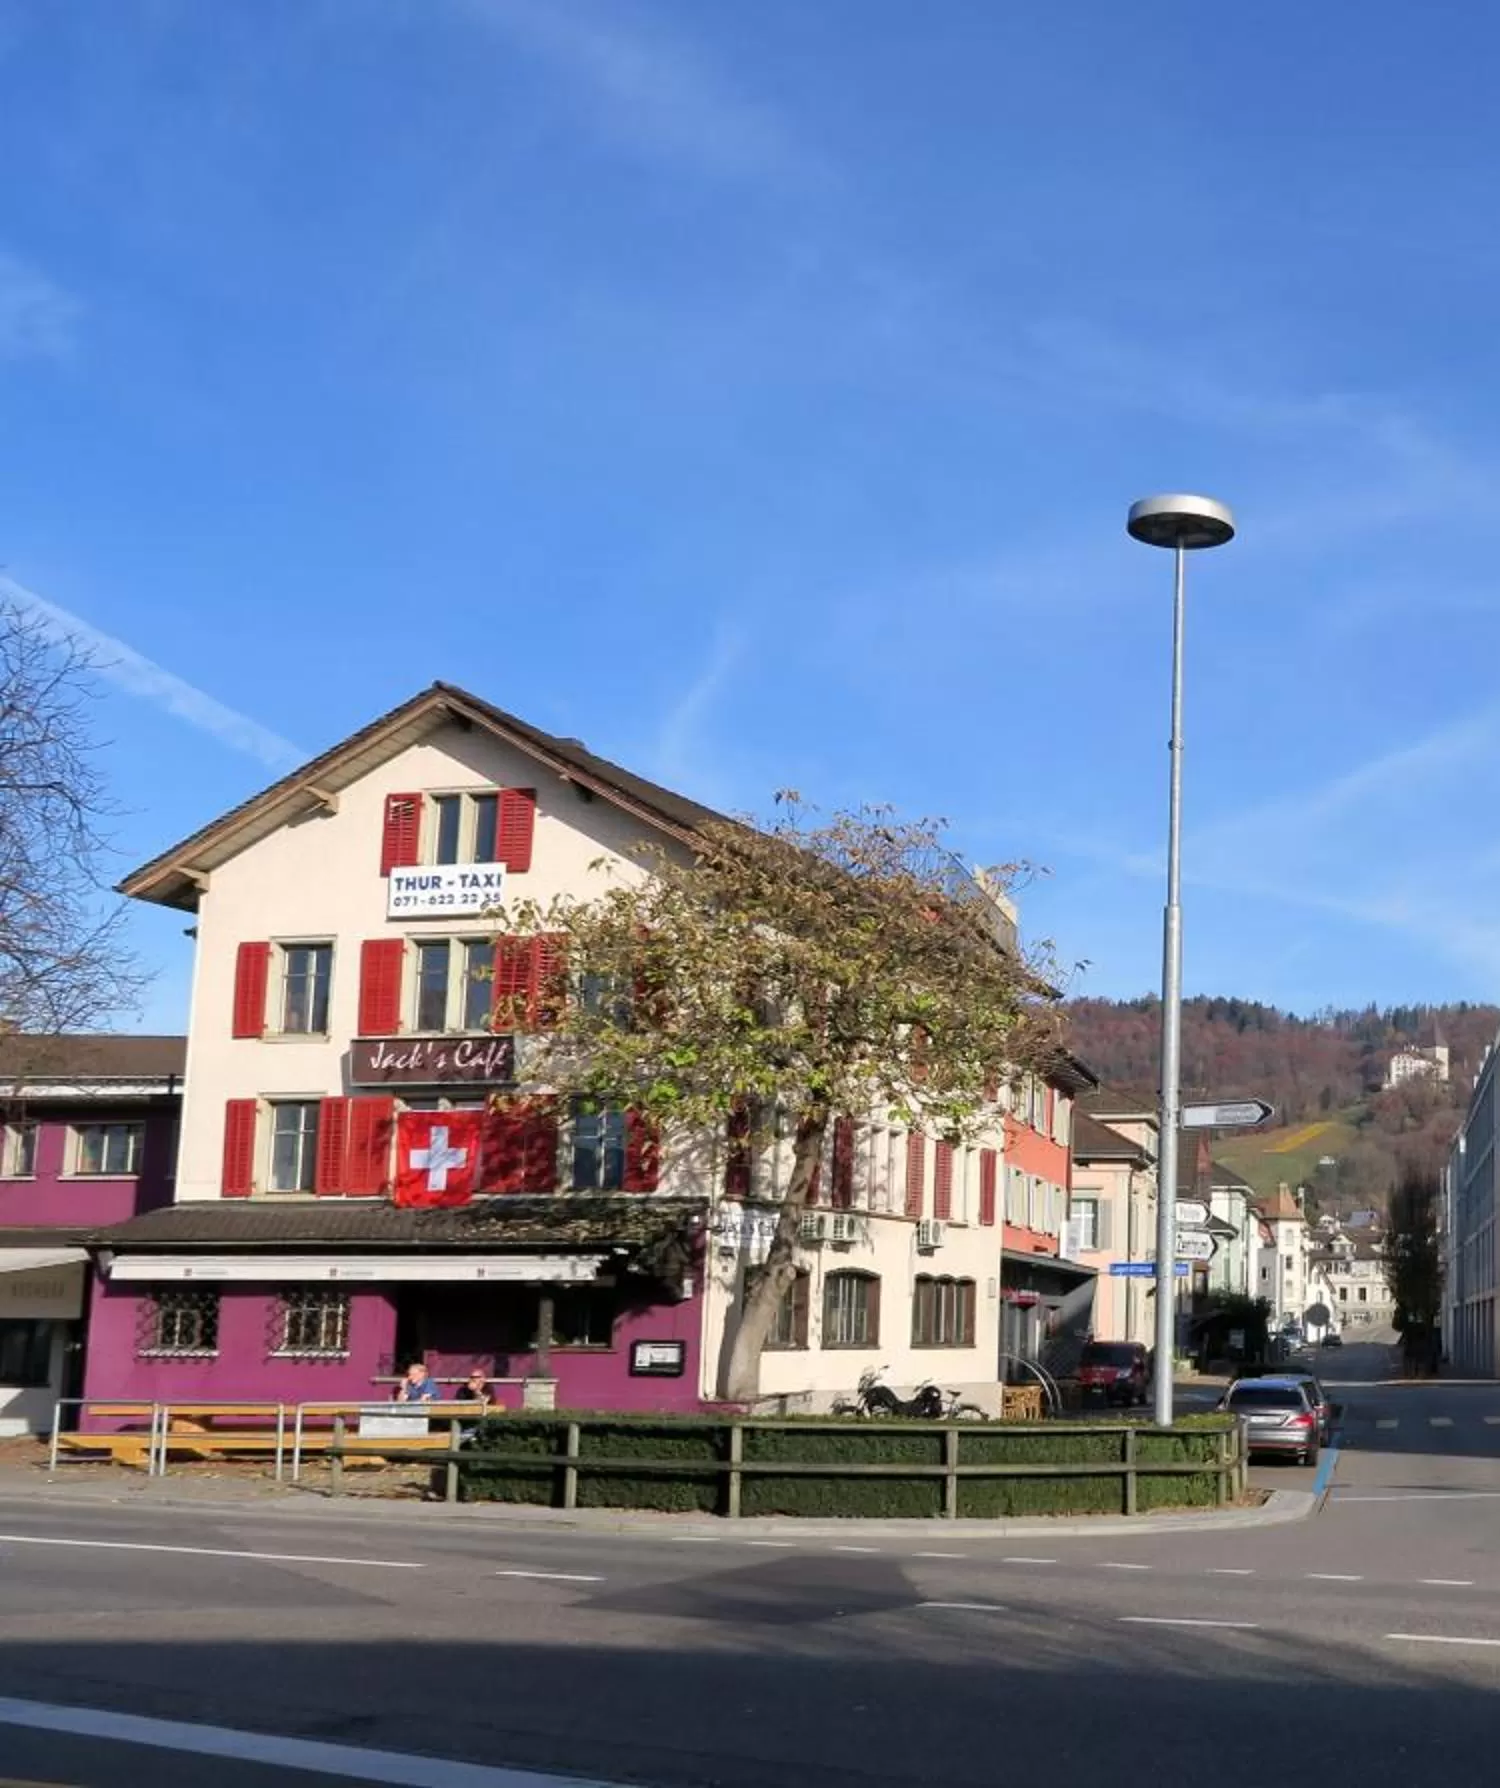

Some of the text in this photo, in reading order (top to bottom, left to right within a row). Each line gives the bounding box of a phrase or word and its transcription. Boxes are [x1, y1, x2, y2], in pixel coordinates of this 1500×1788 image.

[394, 875, 443, 891] THUR
[458, 873, 502, 889] TAXI
[393, 893, 455, 907] 071-622
[459, 893, 478, 905] 22
[370, 1041, 447, 1069] Jack's
